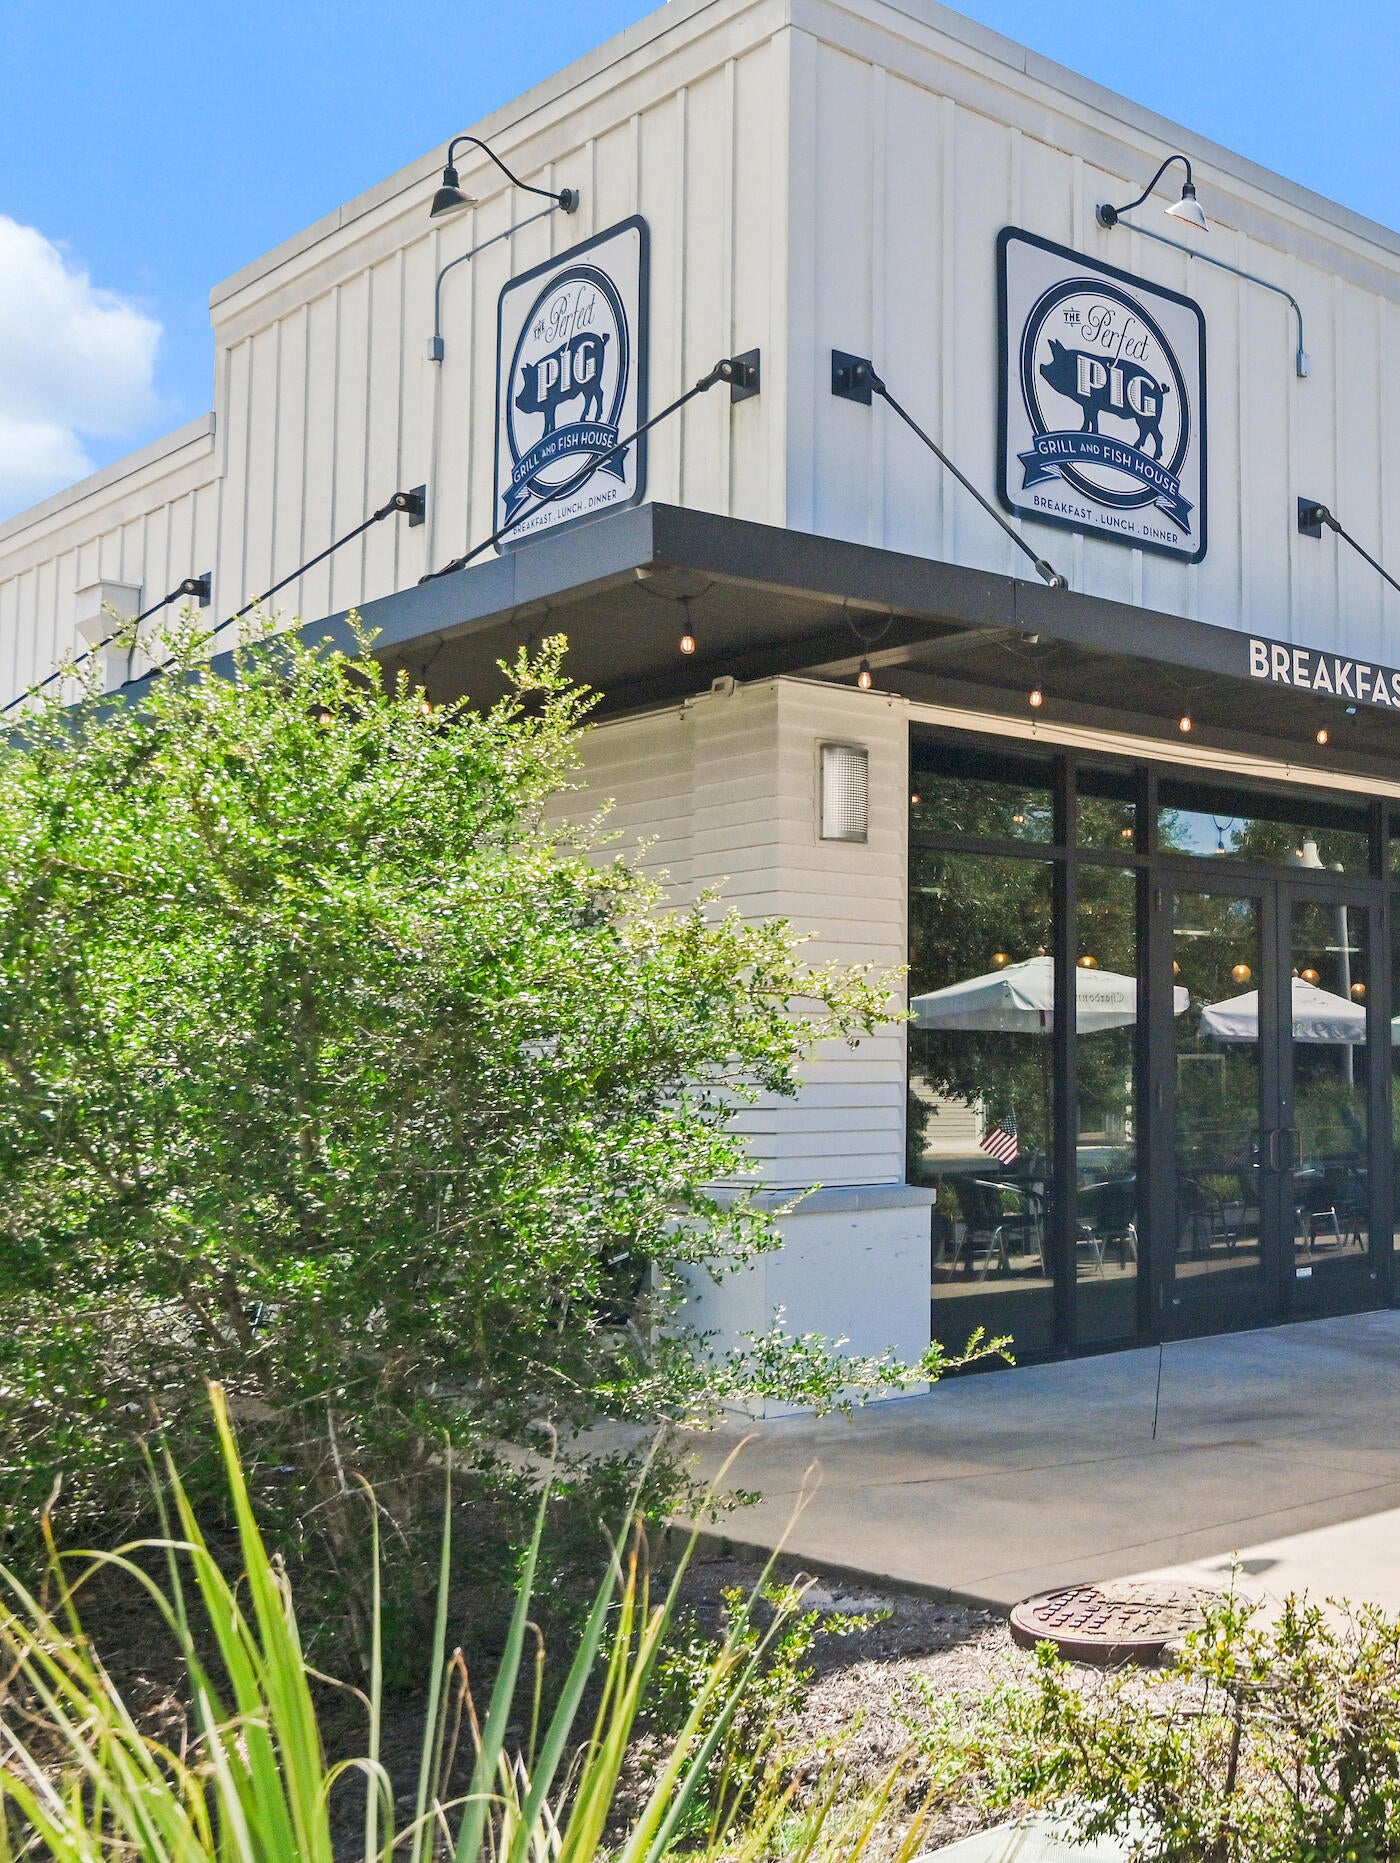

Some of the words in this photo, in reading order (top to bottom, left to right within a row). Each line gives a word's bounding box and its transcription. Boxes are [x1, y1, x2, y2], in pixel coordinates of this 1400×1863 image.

[534, 321, 545, 338] THE
[545, 286, 595, 356] Perfect
[1064, 312, 1080, 322] THE
[1081, 305, 1149, 368] Perfect
[537, 341, 596, 402] PIG
[1077, 355, 1156, 416] PIG
[514, 454, 540, 483] GRILL
[541, 443, 556, 458] AND
[558, 433, 579, 450] FISH
[581, 431, 615, 448] HOUSE
[1039, 440, 1076, 454] GRILL
[1080, 443, 1100, 455] AND
[1103, 446, 1131, 466] FISH
[1135, 461, 1178, 495] HOUSE
[513, 512, 552, 535] BREAKFAST
[557, 502, 582, 519] LUNCH
[588, 489, 617, 508] DINNER
[1033, 495, 1092, 520] BREAKFAST
[1101, 514, 1135, 532] LUNCH
[1143, 525, 1178, 544] DINNER
